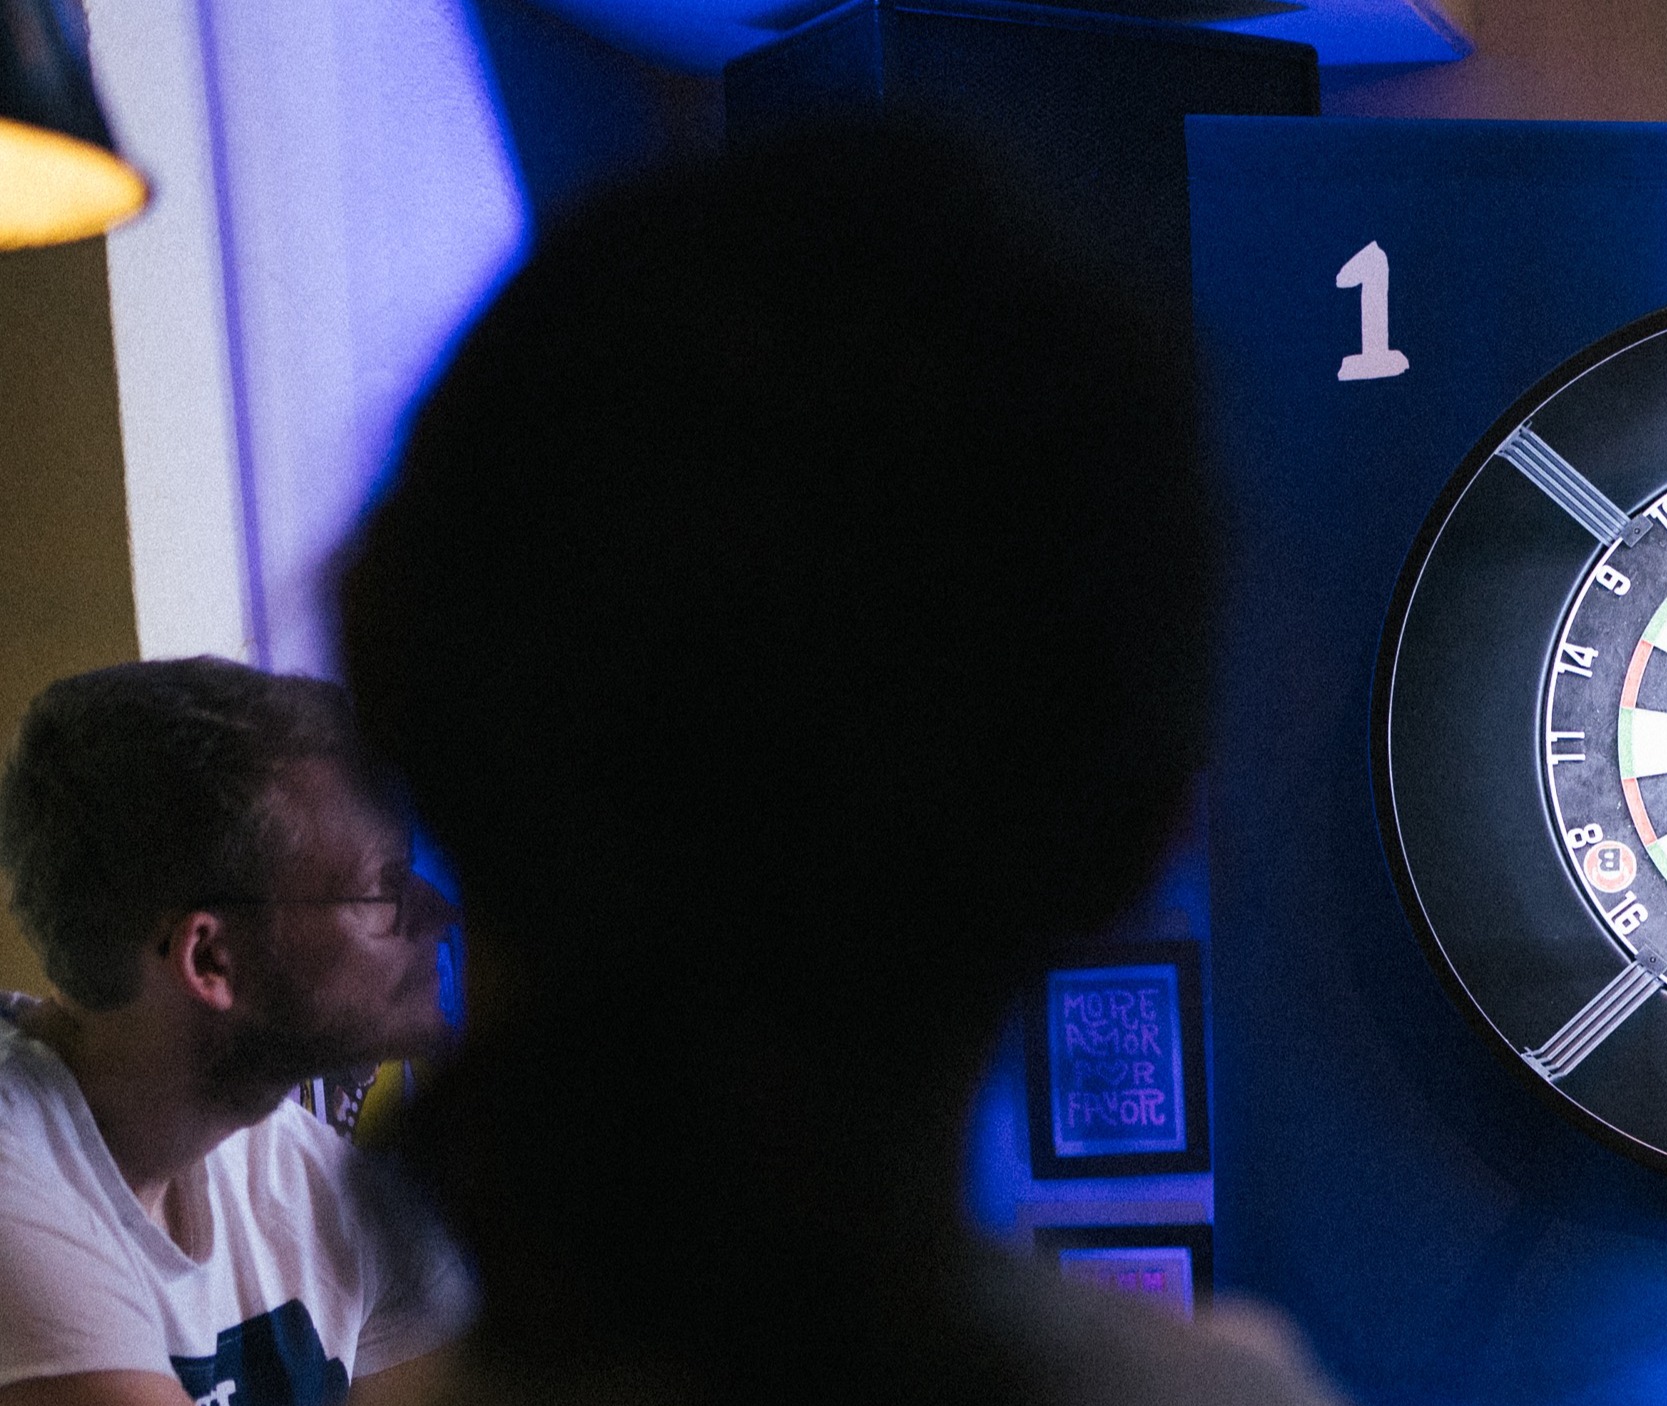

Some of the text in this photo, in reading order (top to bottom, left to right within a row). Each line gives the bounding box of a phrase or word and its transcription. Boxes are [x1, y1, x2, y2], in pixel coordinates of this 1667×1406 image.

[1336, 240, 1409, 381] 1
[1596, 564, 1631, 596] 9
[1555, 642, 1599, 678] 14
[1550, 731, 1586, 764] 11
[1567, 822, 1604, 849] 8
[1608, 890, 1648, 935] 16
